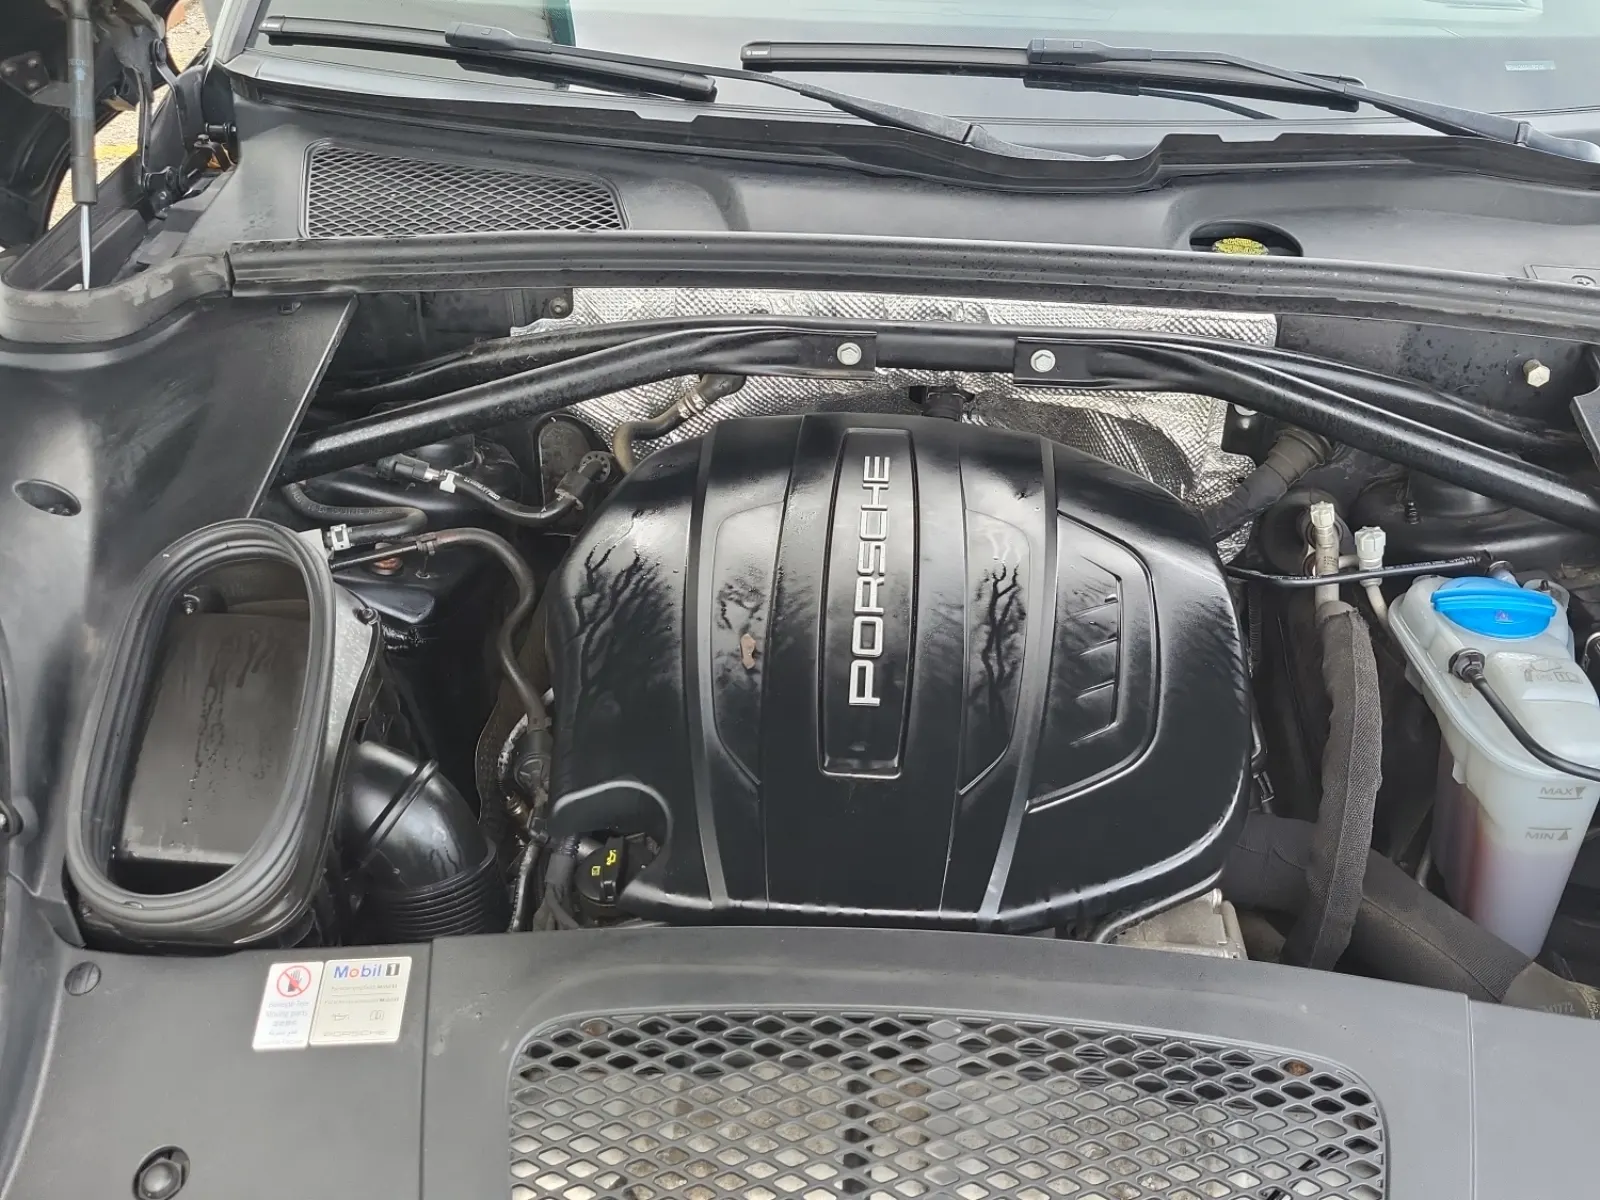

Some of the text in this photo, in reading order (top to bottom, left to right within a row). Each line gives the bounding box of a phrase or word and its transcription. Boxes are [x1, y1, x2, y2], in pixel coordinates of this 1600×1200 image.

[849, 456, 890, 706] PORSCHE
[1541, 787, 1573, 795] MAX
[1525, 832, 1555, 840] MIN
[334, 963, 400, 978] Mobil 1
